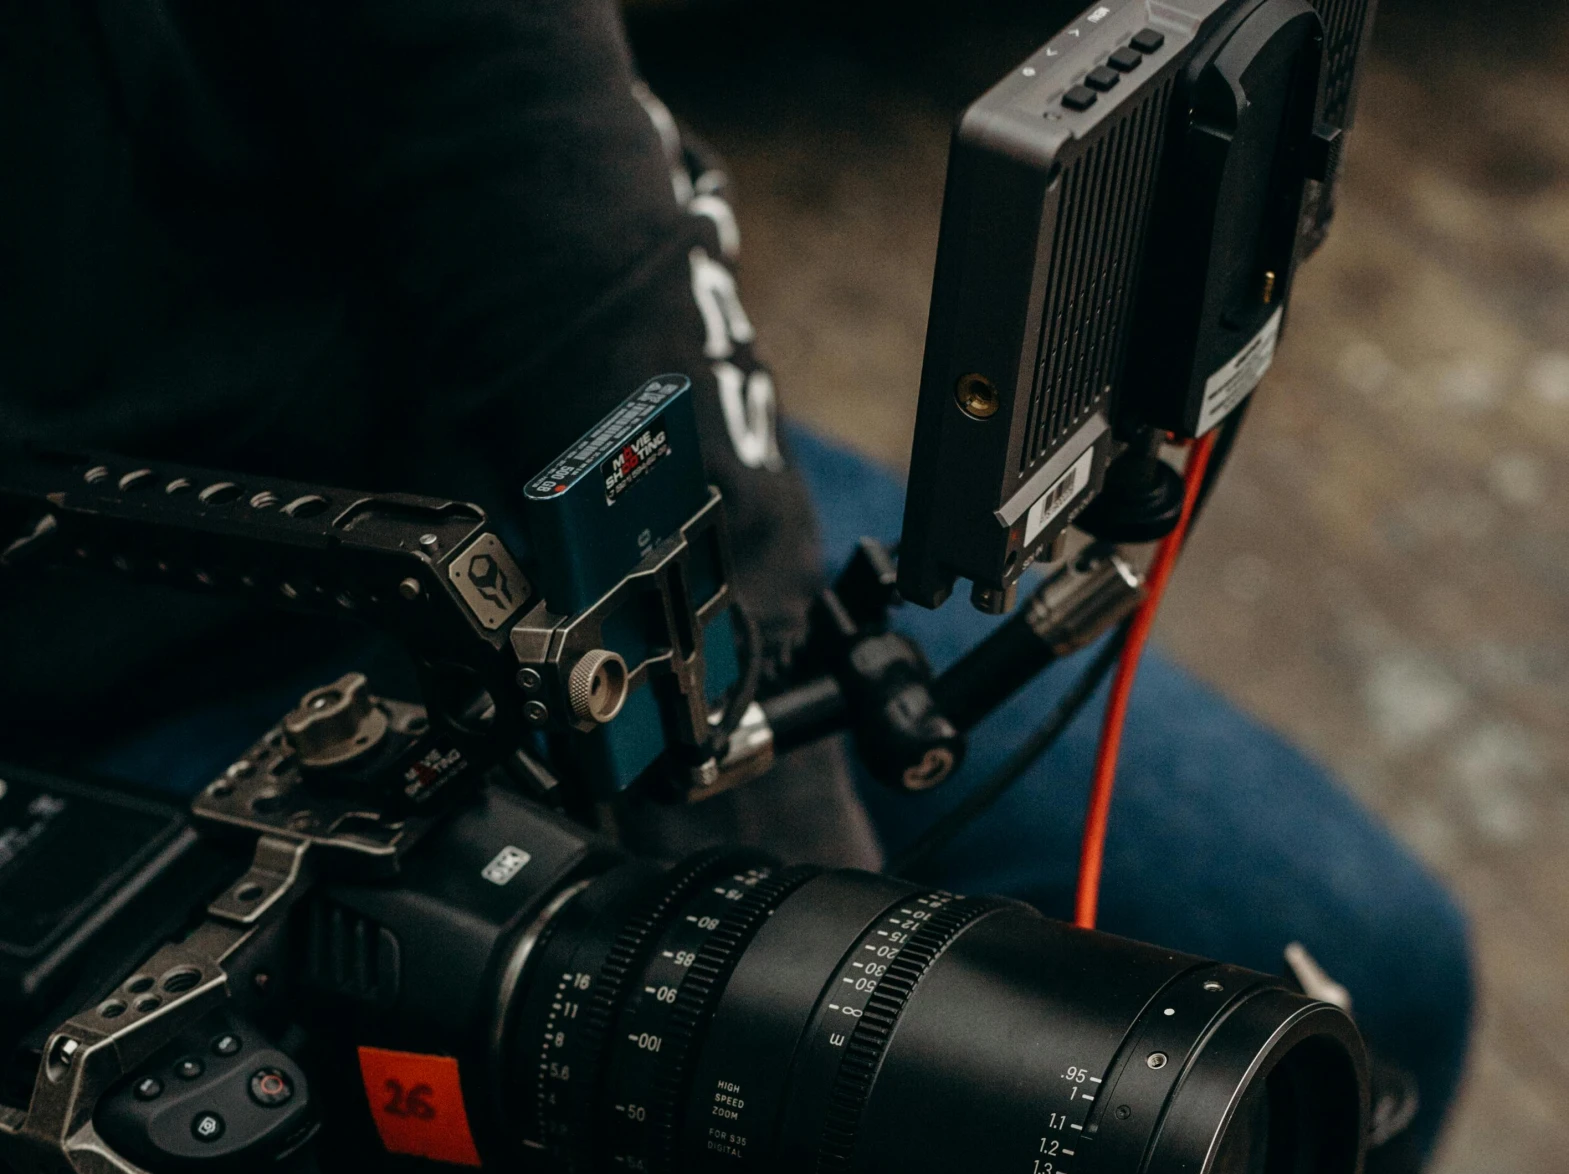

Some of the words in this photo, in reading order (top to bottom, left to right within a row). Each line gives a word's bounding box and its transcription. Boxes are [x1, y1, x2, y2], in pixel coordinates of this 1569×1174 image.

[612, 430, 653, 472] MOVIE
[605, 430, 667, 490] SHOOTING
[696, 916, 721, 931] 80
[901, 919, 921, 931] 12
[888, 931, 908, 944] 15
[673, 951, 696, 967] 85
[877, 945, 899, 959] 20
[865, 962, 887, 977] 30
[573, 972, 592, 991] 16
[855, 977, 877, 993] 50
[656, 986, 678, 1004] 90
[563, 1001, 579, 1019] 11
[554, 1031, 565, 1049] 8
[637, 1032, 663, 1053] 100
[1060, 1066, 1088, 1083] .95
[717, 1079, 740, 1094] HIGH
[1070, 1086, 1078, 1101] 1
[714, 1092, 745, 1109] SPEED
[627, 1104, 646, 1122] 50
[711, 1104, 739, 1121] ZOOM
[1049, 1112, 1067, 1131] 1.1
[708, 1127, 727, 1140] FOR
[728, 1133, 747, 1147] S35
[707, 1140, 743, 1159] DIGITAL
[1039, 1137, 1060, 1157] 1.2
